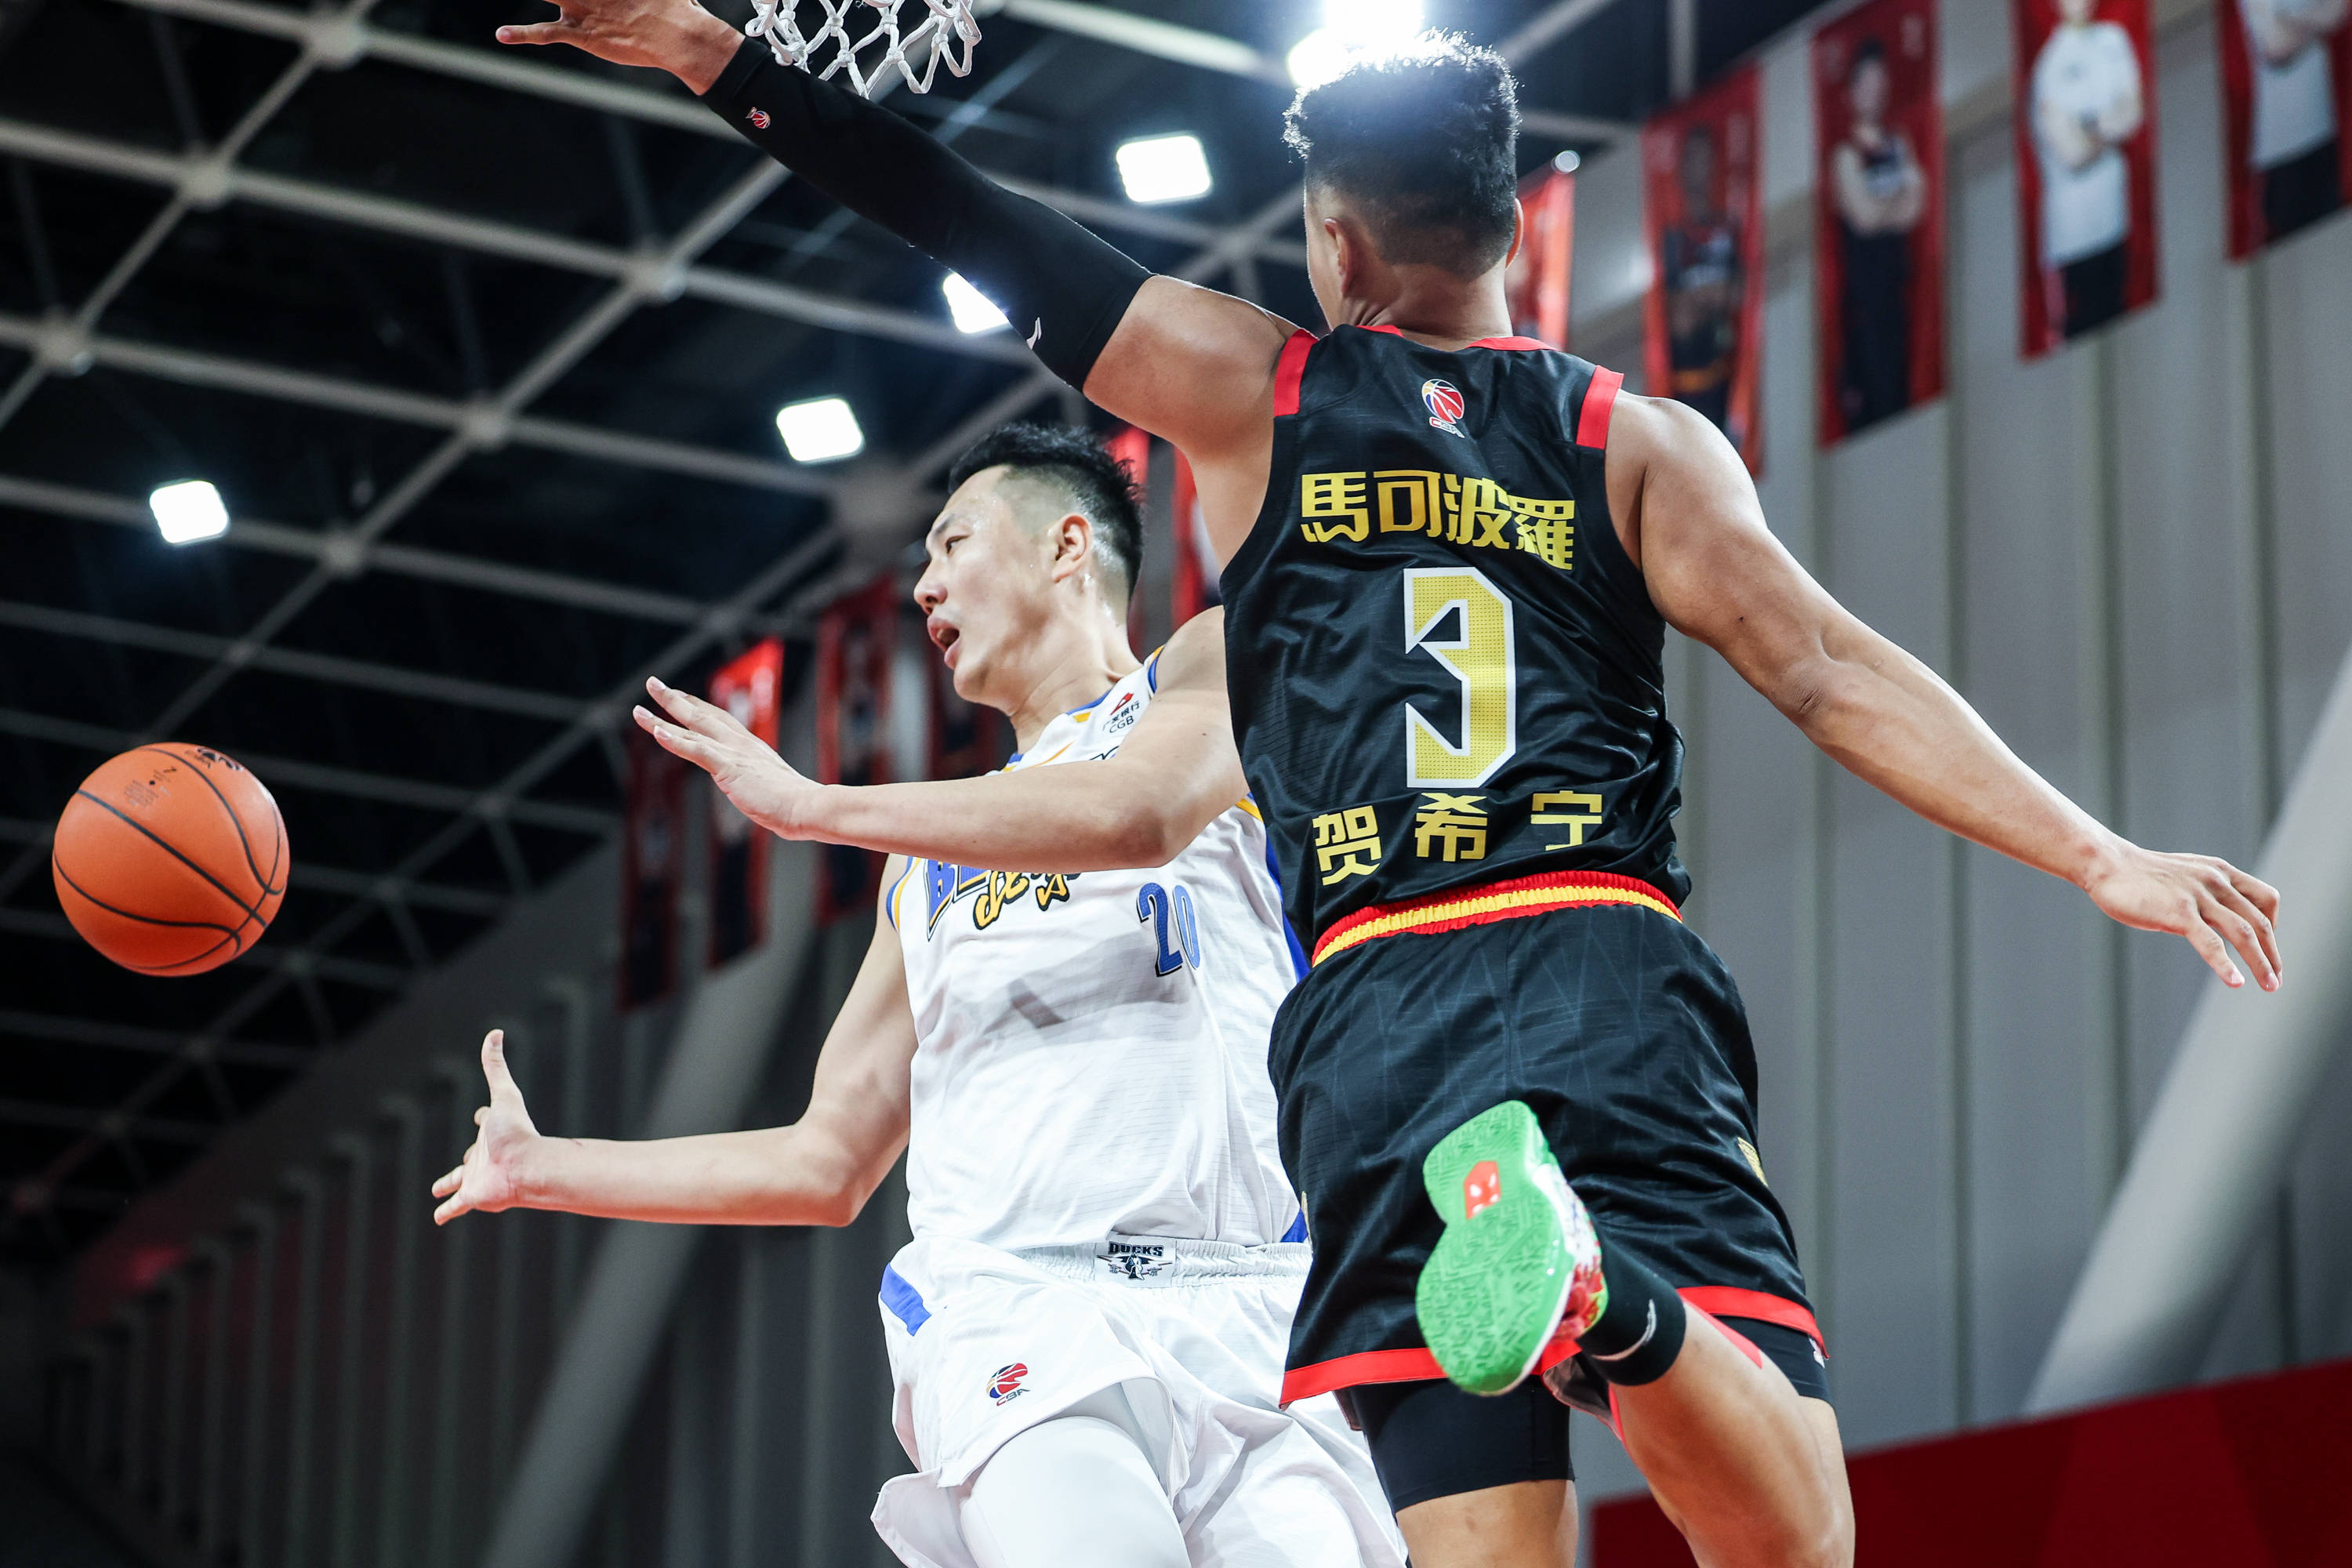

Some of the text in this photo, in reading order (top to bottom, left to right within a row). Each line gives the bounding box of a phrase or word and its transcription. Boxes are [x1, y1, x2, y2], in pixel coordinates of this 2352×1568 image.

[1300, 469, 1575, 571] 馬可波羅
[1109, 715, 1134, 733] CGB
[1403, 567, 1516, 789] 3
[1312, 790, 1602, 886] 贺希宁
[1136, 882, 1200, 977] 20
[1108, 1241, 1163, 1256] DUCKS
[996, 1388, 1031, 1406] CBA
